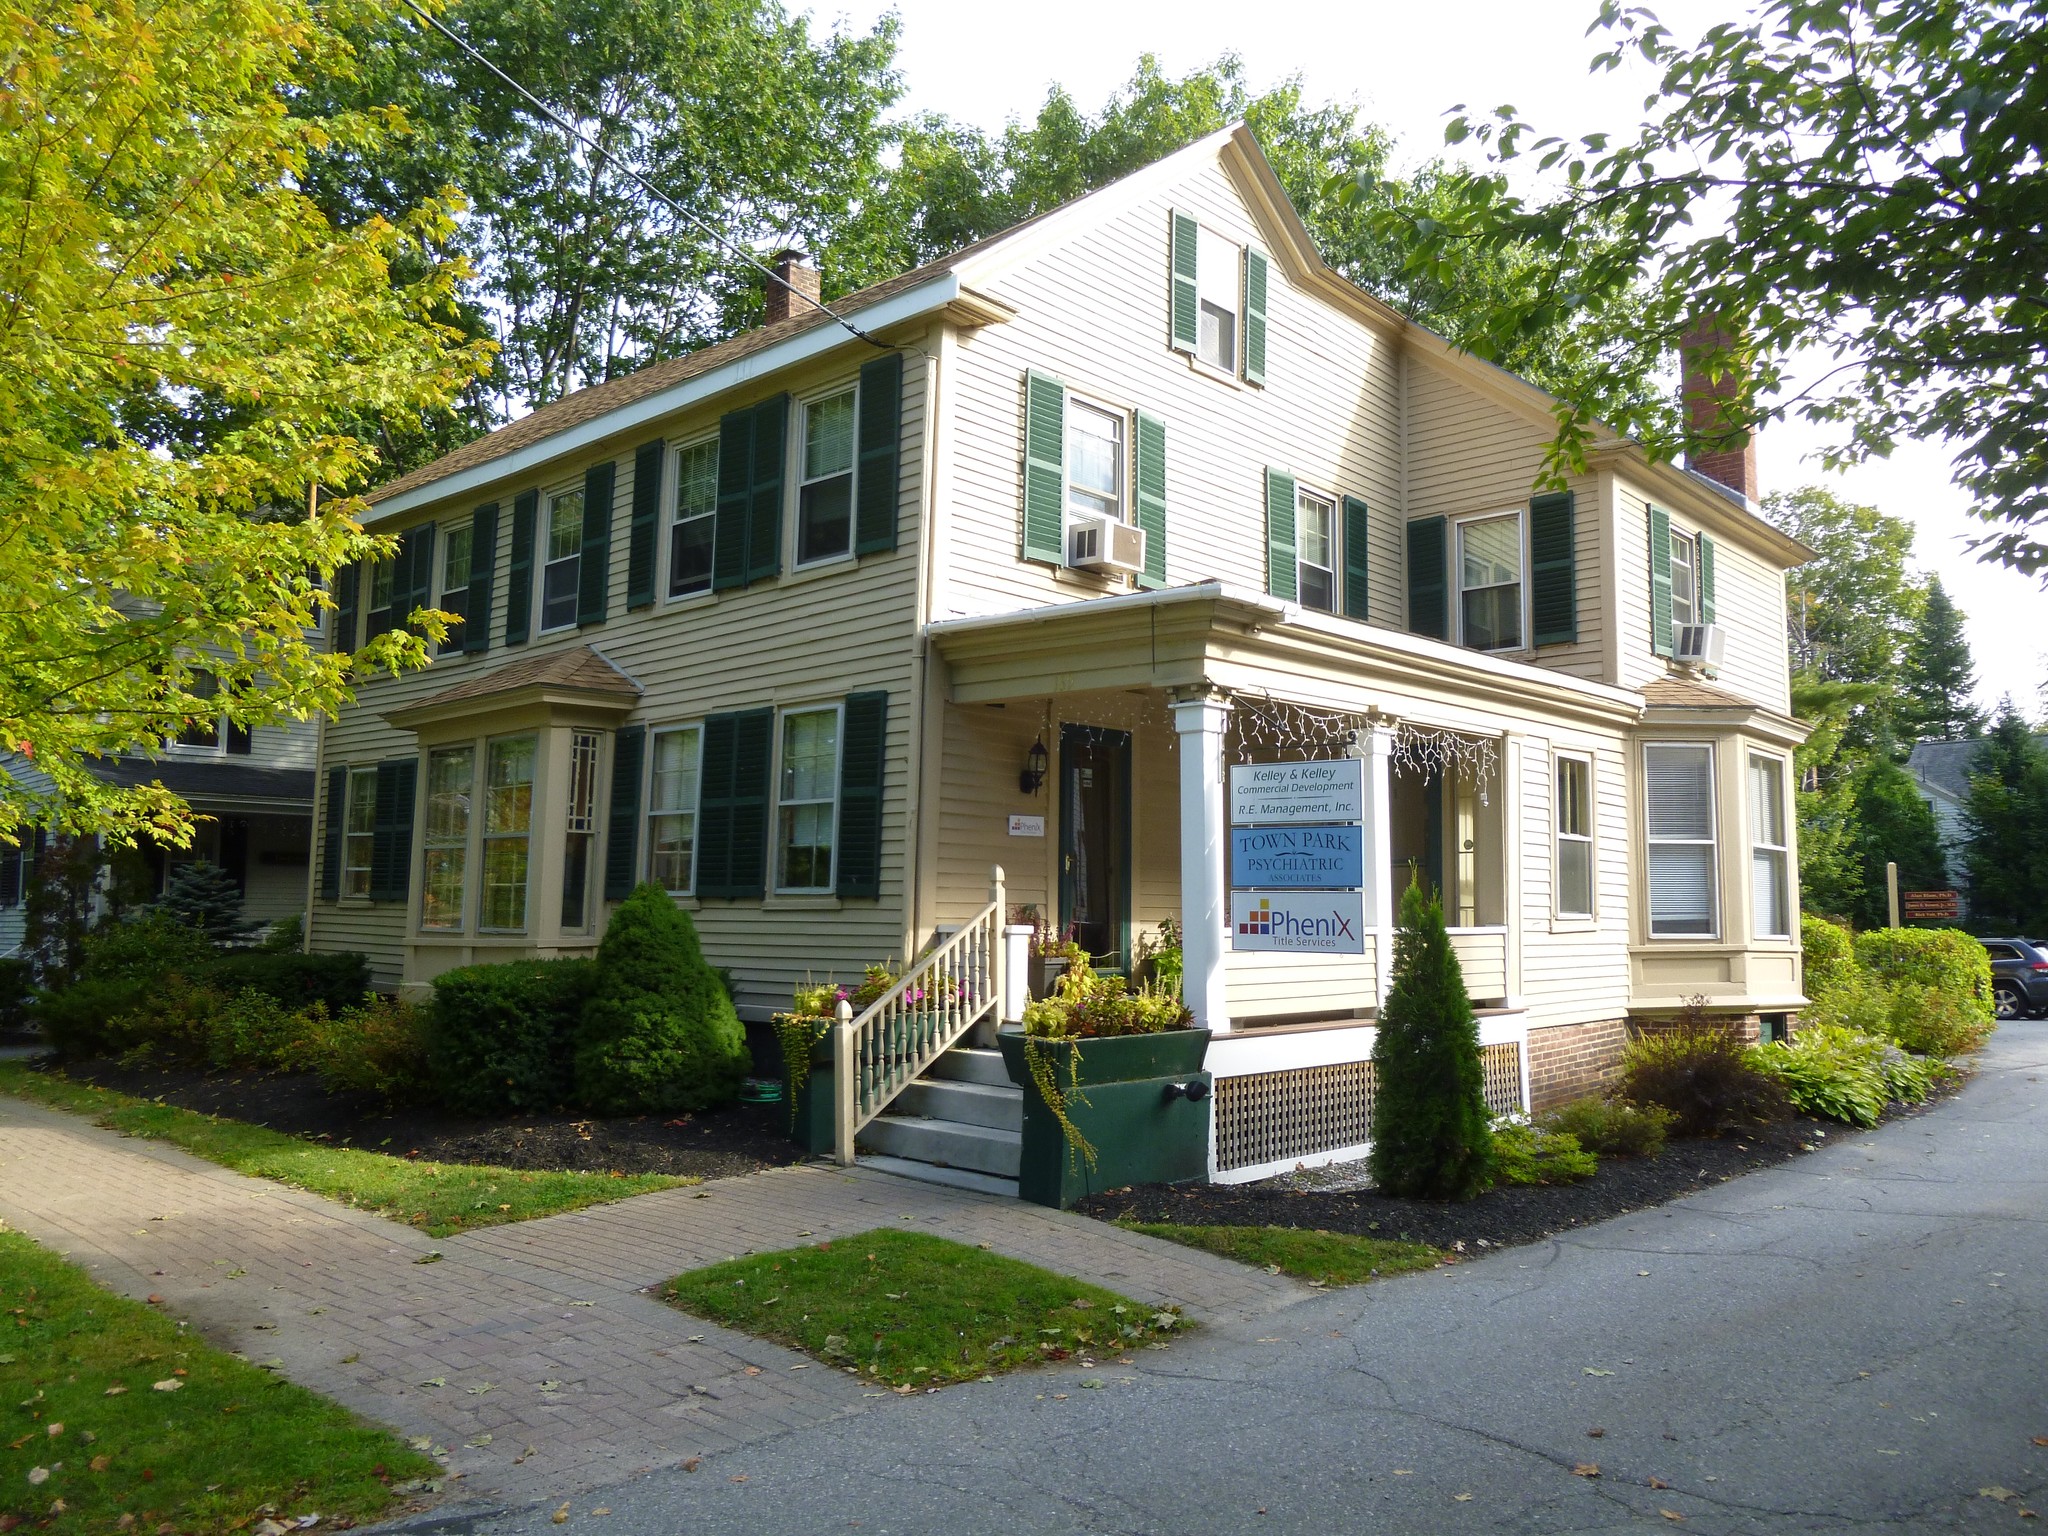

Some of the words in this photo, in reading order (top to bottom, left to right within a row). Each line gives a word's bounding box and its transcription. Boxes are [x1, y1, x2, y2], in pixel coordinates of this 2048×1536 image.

[1253, 770, 1286, 783] Kelley
[1289, 769, 1298, 780] &
[1301, 768, 1336, 781] Kelley
[1237, 784, 1289, 794] Commercial
[1291, 781, 1354, 793] Development
[1238, 805, 1258, 815] R.E.
[1260, 803, 1332, 816] Management,
[1335, 802, 1354, 811] Inc.
[1240, 832, 1296, 852] TOWN
[1303, 832, 1351, 851] PARK
[1248, 857, 1344, 870] PSYCHIATRIC
[1269, 874, 1322, 882] ASSOCIATES
[1273, 936, 1294, 946] Title
[1296, 936, 1336, 947] Services
